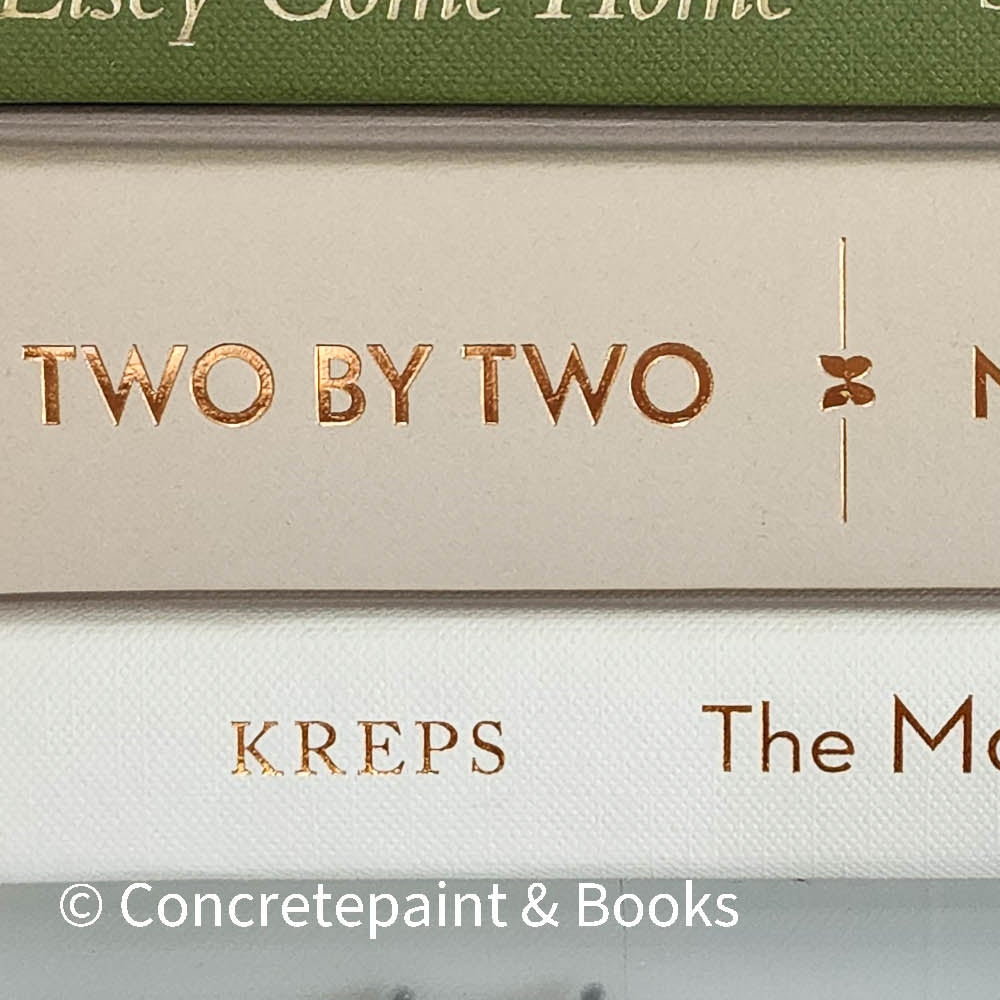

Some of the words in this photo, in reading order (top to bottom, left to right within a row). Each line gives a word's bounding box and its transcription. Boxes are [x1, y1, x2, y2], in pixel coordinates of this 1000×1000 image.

[22, 343, 275, 427] TWO
[313, 343, 434, 427] BY
[461, 342, 714, 427] TWO
[230, 720, 507, 776] KREPS
[702, 700, 855, 774] The
